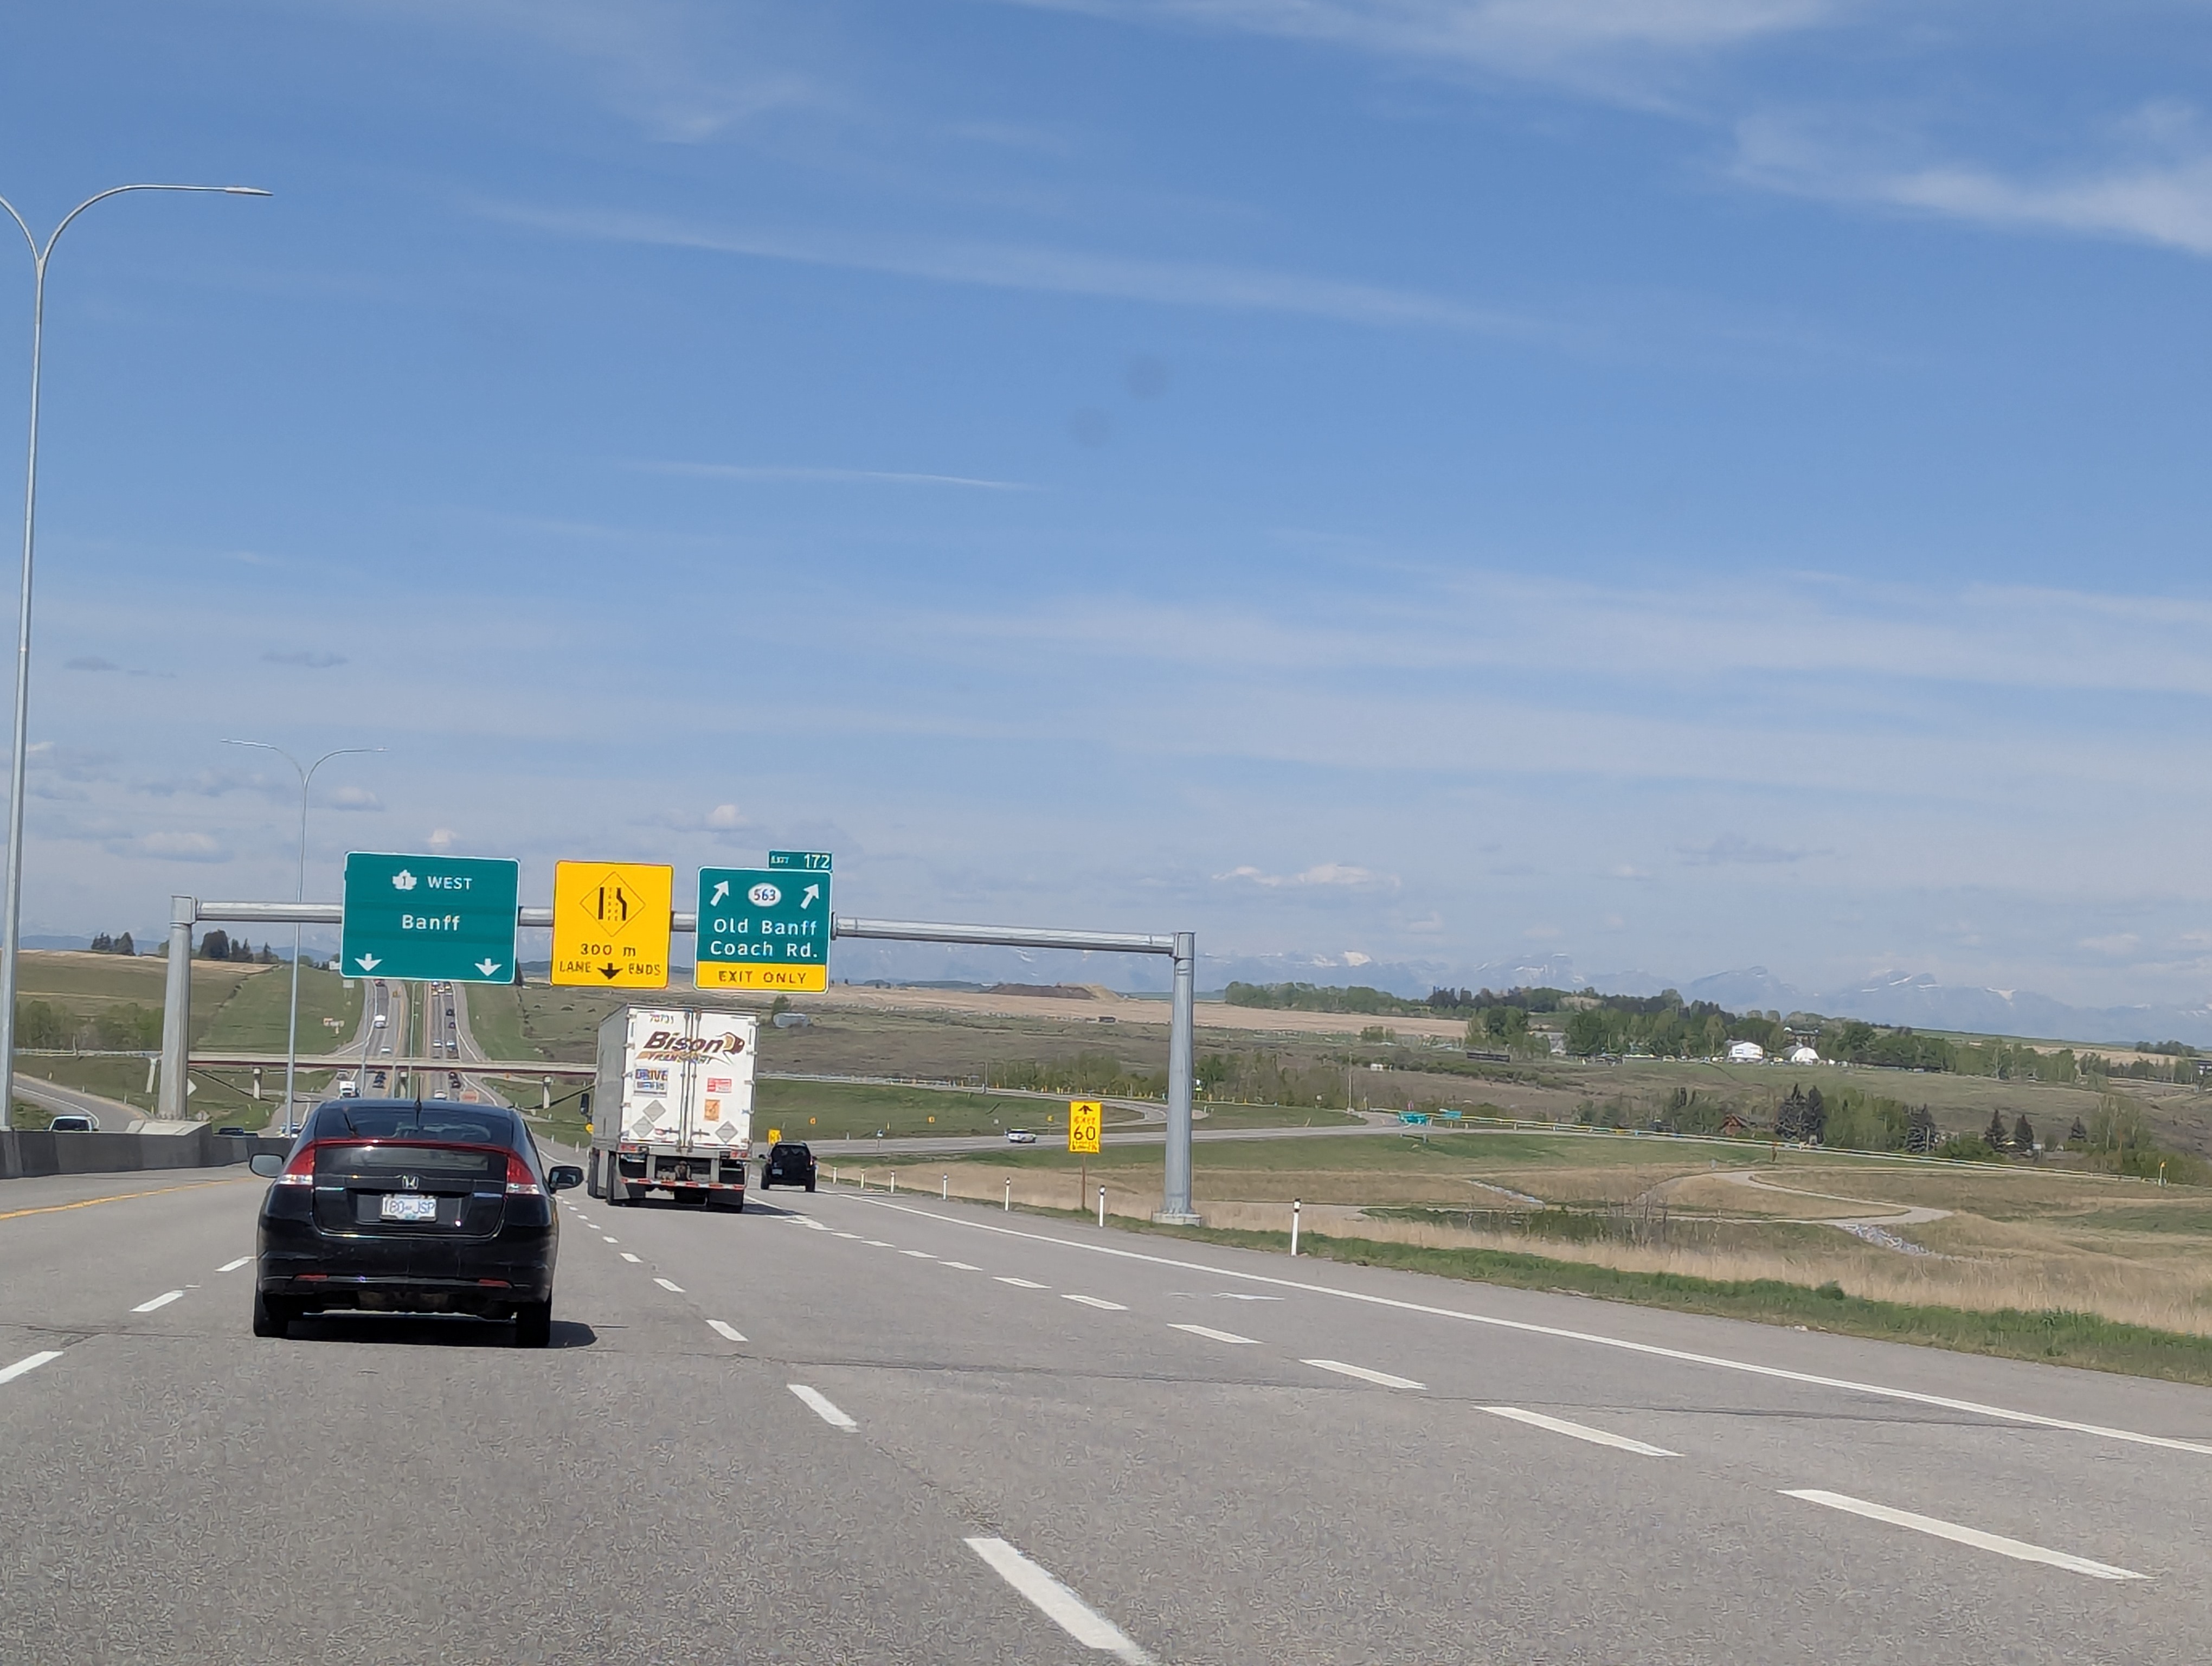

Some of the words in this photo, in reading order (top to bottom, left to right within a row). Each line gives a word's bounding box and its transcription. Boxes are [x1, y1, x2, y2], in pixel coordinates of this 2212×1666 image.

[804, 854, 830, 868] 172
[427, 876, 473, 890] WEST
[754, 888, 776, 901] 563
[402, 914, 460, 931] Banff
[713, 918, 748, 933] Old
[761, 920, 817, 935] Banff
[581, 943, 612, 956] 300
[623, 946, 636, 957] m
[710, 941, 773, 957] Coach
[787, 942, 818, 958] Rd.
[560, 960, 591, 973] LANE
[628, 963, 661, 976] ENDS
[718, 970, 753, 983] EXIT
[763, 971, 807, 984] ONLY
[644, 1031, 724, 1053] Bison
[1074, 1125, 1095, 1140] 60
